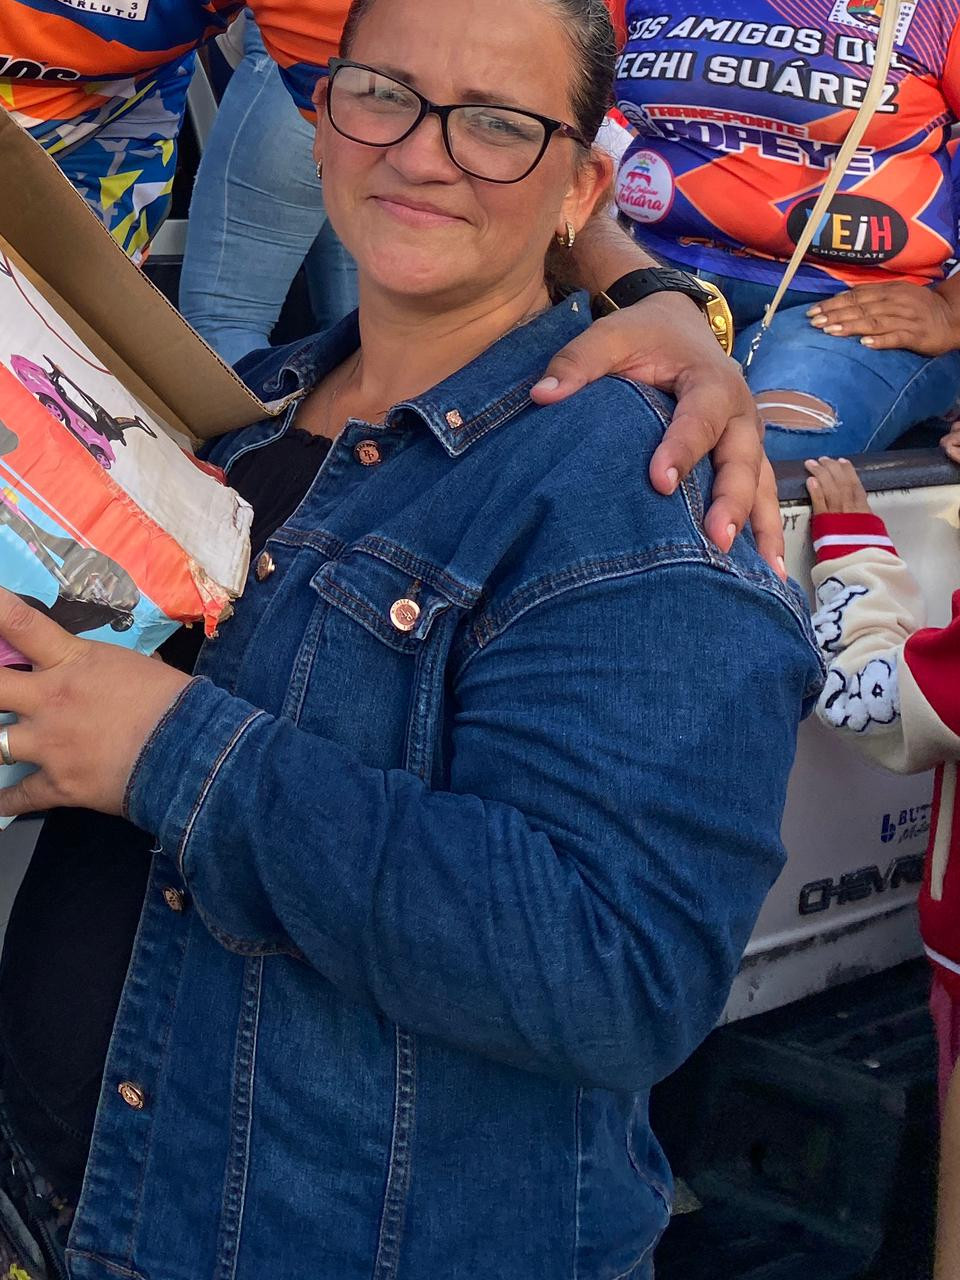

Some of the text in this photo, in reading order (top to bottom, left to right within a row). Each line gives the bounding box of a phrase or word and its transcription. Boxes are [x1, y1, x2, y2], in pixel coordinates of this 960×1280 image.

[665, 16, 822, 55] AMIGOS
[615, 51, 896, 112] ECHI SUÁREZ
[644, 105, 809, 138] TRANSPORTE
[654, 118, 876, 176] POPEYE
[812, 247, 885, 259] CHOCOLATE
[799, 852, 926, 915] CHEVR
